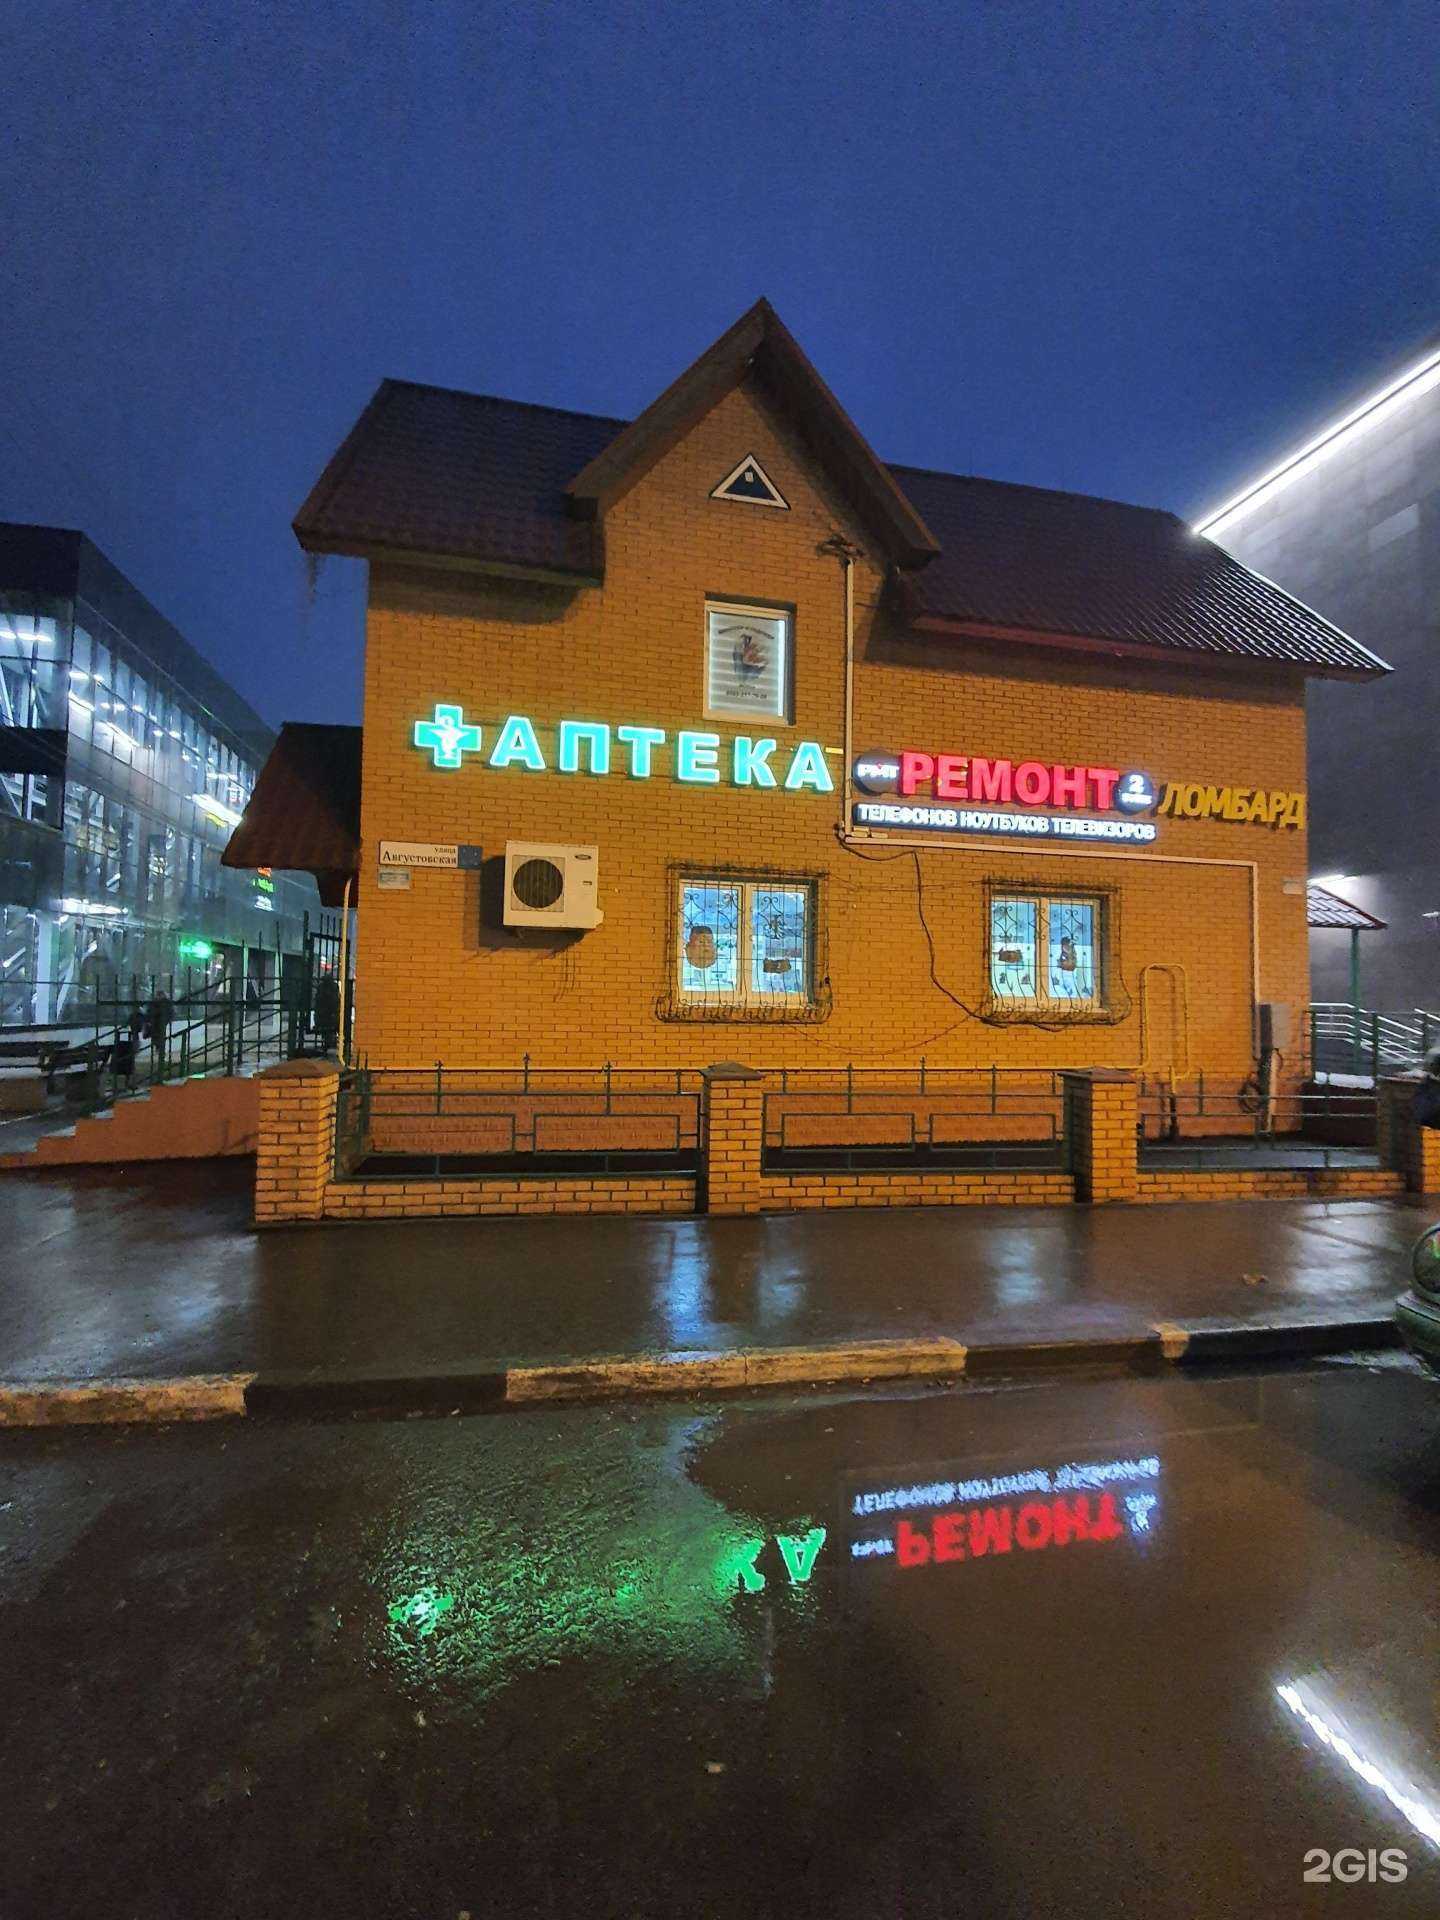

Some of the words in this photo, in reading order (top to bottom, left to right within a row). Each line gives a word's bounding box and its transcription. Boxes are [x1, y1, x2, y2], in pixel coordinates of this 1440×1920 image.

[489, 715, 834, 792] АПТЕКА
[901, 752, 1119, 810] РЕМОНТ
[858, 804, 957, 827] ТЕЛЕФОНОВ
[960, 811, 1048, 833] НОУТБУКОВ
[1052, 818, 1156, 840] ТЕЛЕВИЗОРОВ
[1158, 782, 1306, 829] ЛОМБАРД
[382, 850, 457, 865] Августовская
